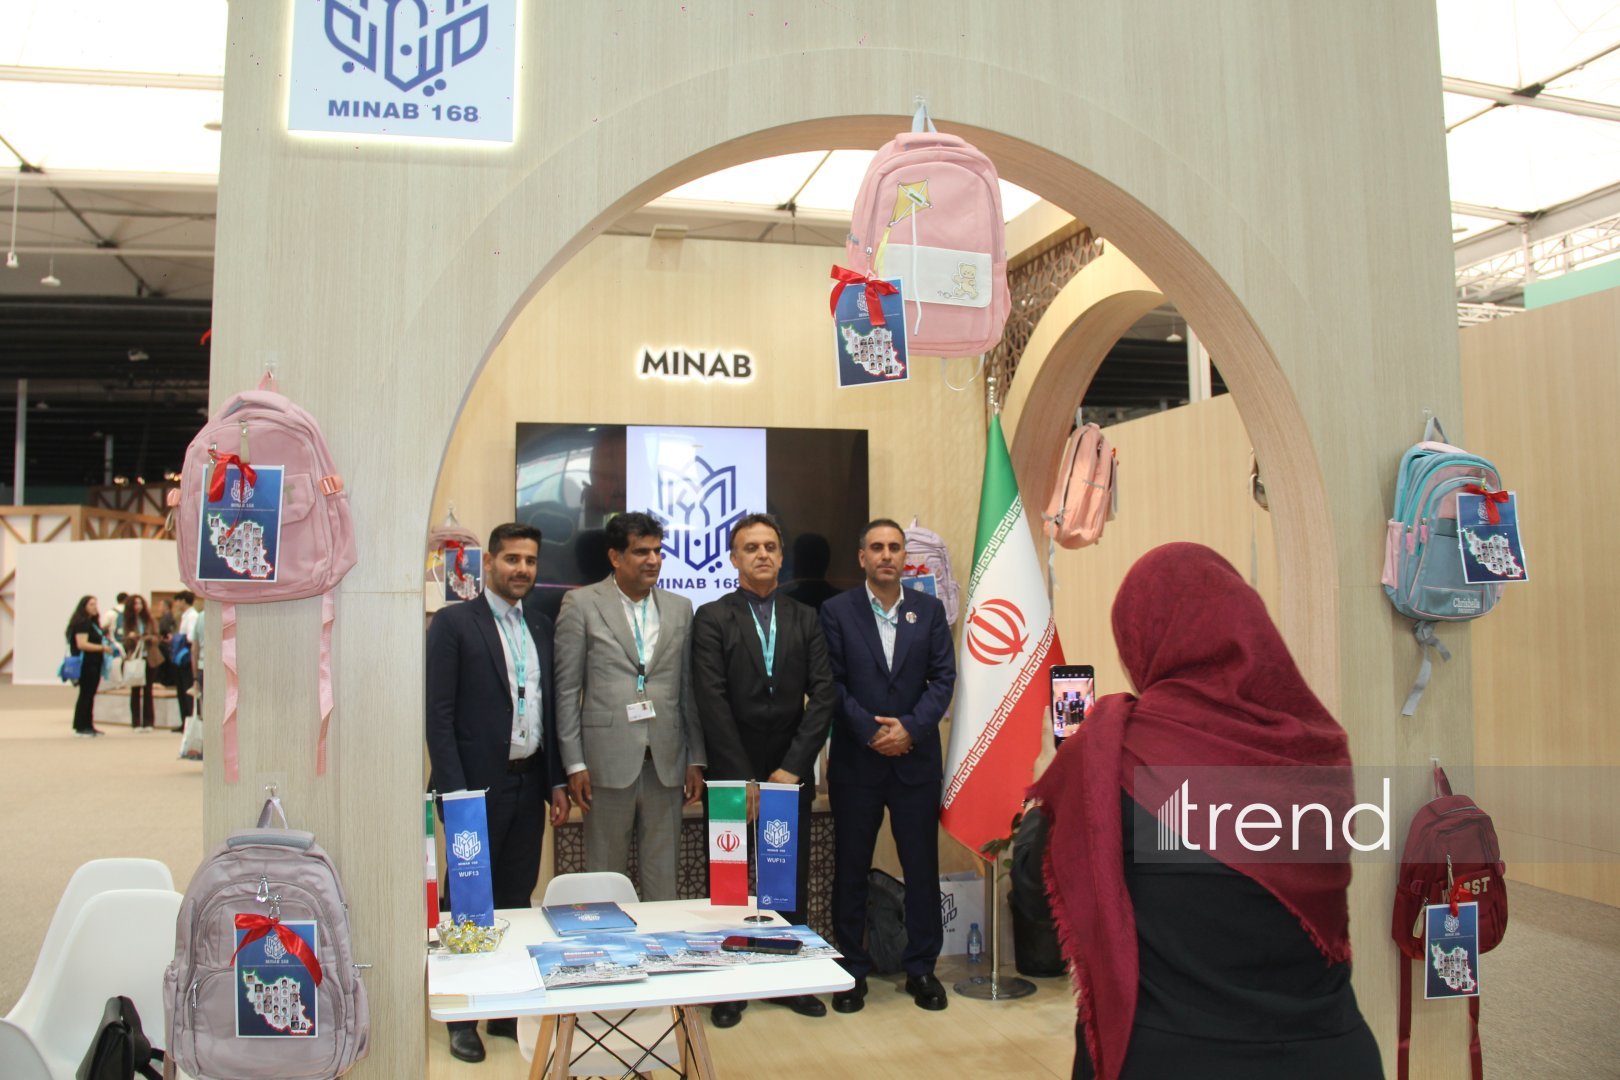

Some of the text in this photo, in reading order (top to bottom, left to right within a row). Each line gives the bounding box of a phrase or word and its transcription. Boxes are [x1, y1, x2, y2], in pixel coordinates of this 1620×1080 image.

[328, 100, 479, 122] MINAB 168
[642, 349, 752, 378] MINAB
